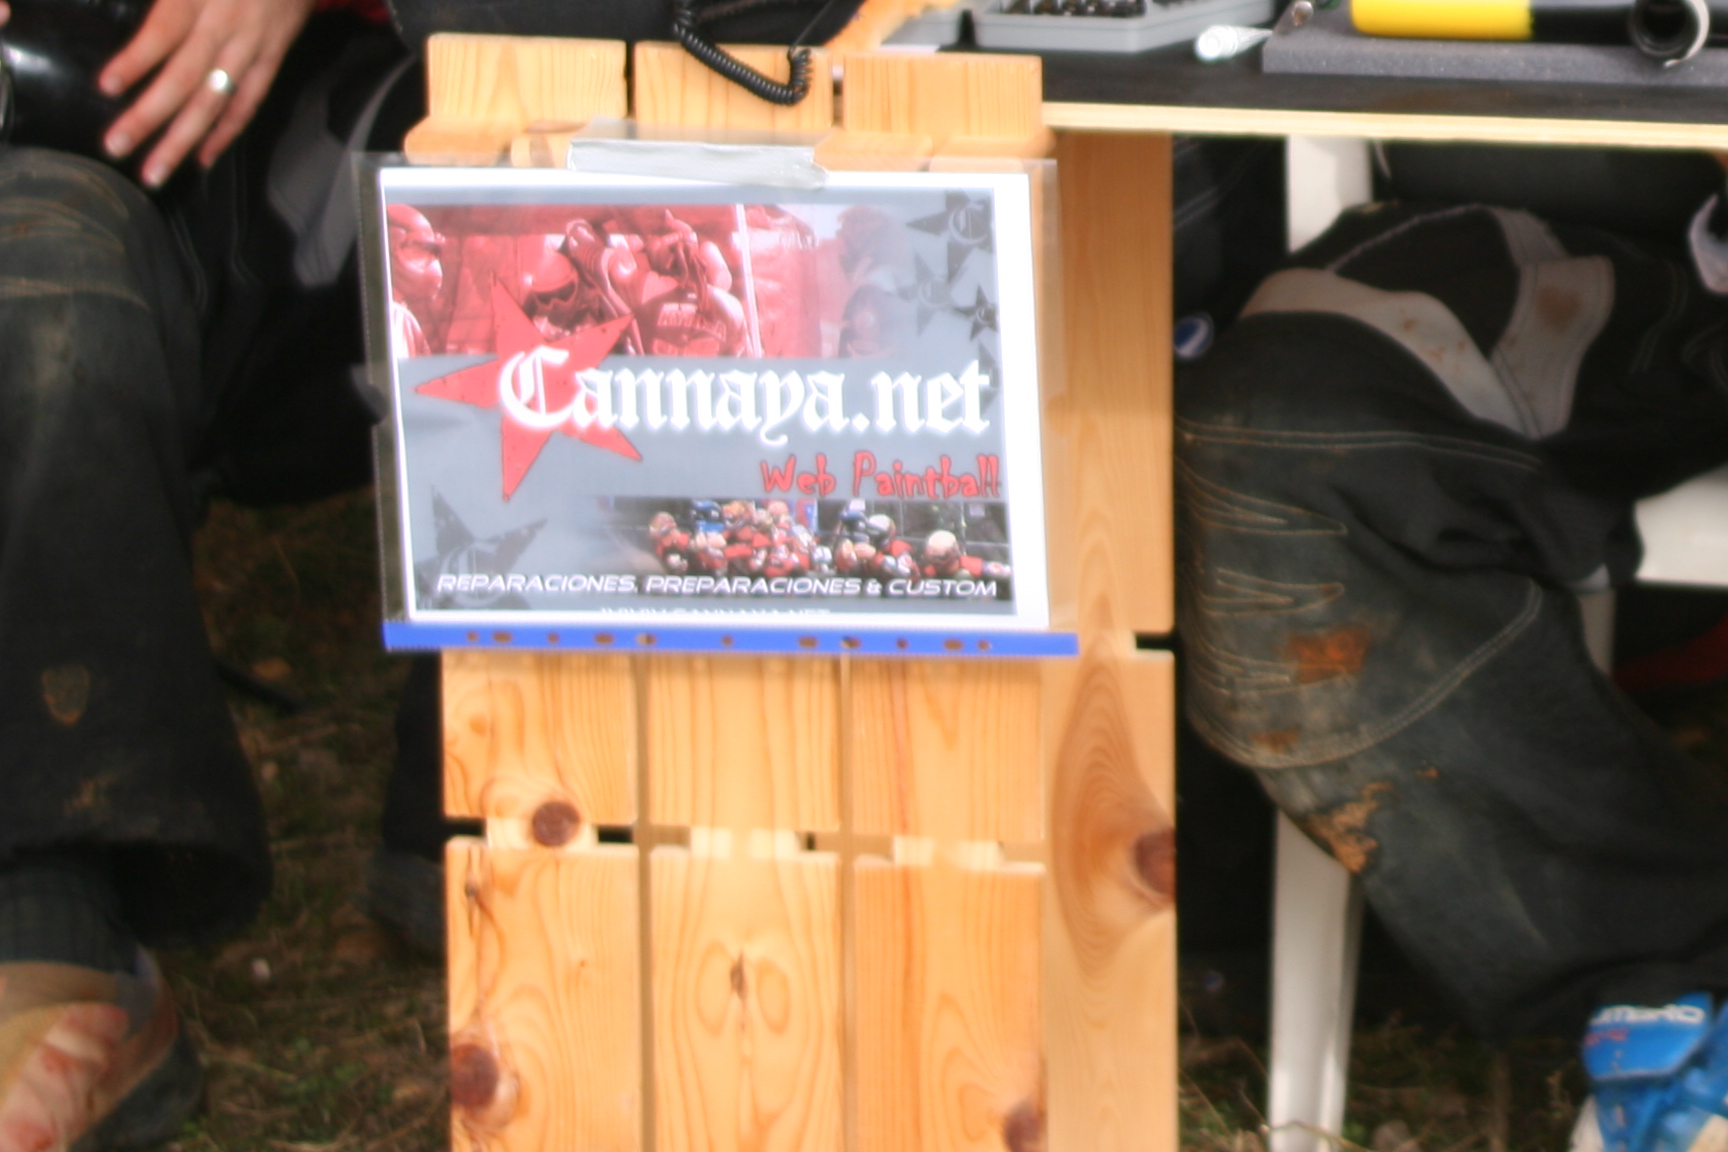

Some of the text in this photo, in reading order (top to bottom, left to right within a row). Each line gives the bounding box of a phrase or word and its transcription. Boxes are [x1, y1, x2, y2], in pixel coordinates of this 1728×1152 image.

[498, 345, 990, 446] Cannaya.net
[760, 450, 999, 498] Web Paintball
[646, 575, 861, 595] PREPARACIONES
[866, 579, 882, 595] &
[888, 579, 997, 596] CUSTOM
